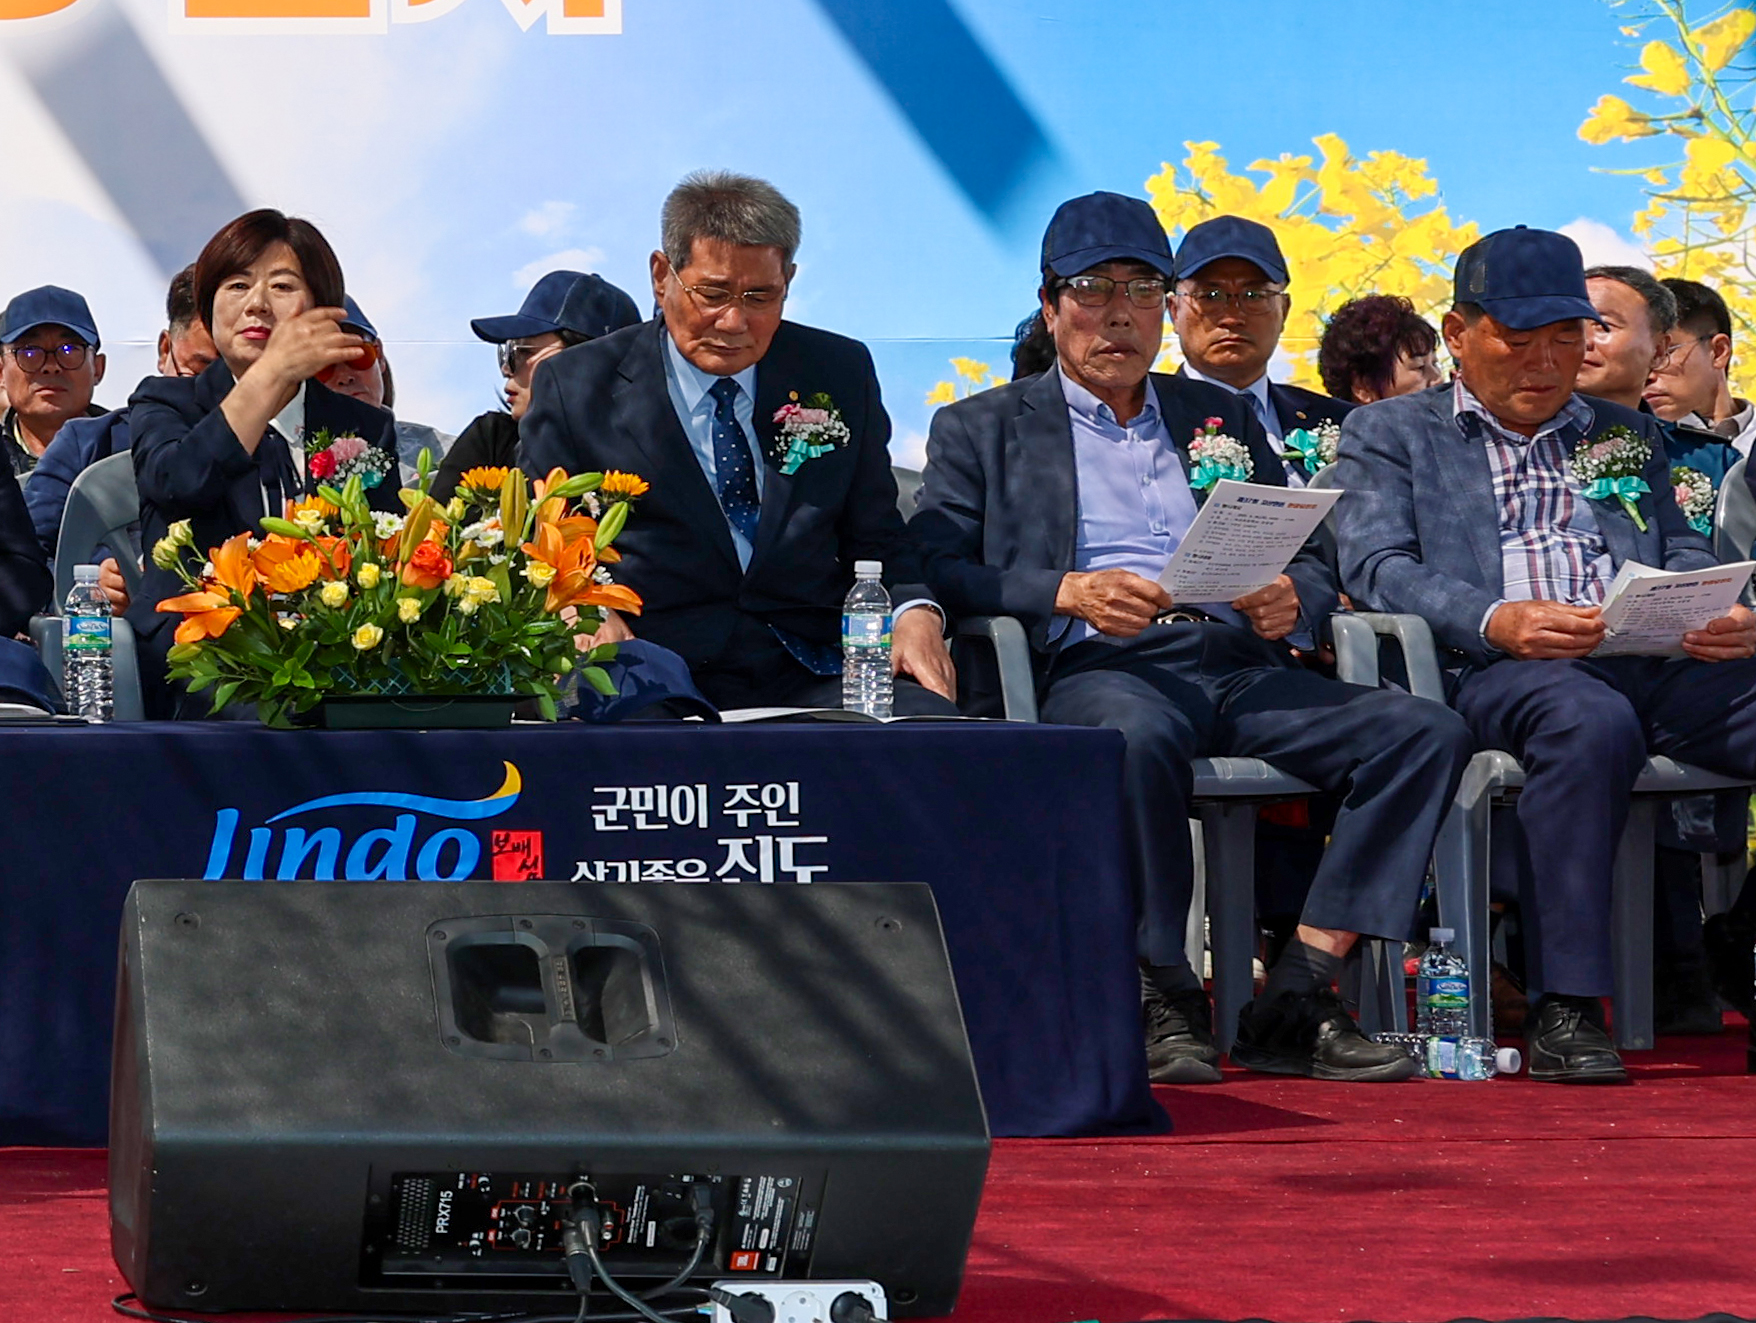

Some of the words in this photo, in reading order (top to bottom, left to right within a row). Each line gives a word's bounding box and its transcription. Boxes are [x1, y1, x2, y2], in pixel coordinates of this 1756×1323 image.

[590, 783, 709, 832] 군민이
[722, 781, 800, 828] 주인
[435, 1190, 454, 1234] PRX715
